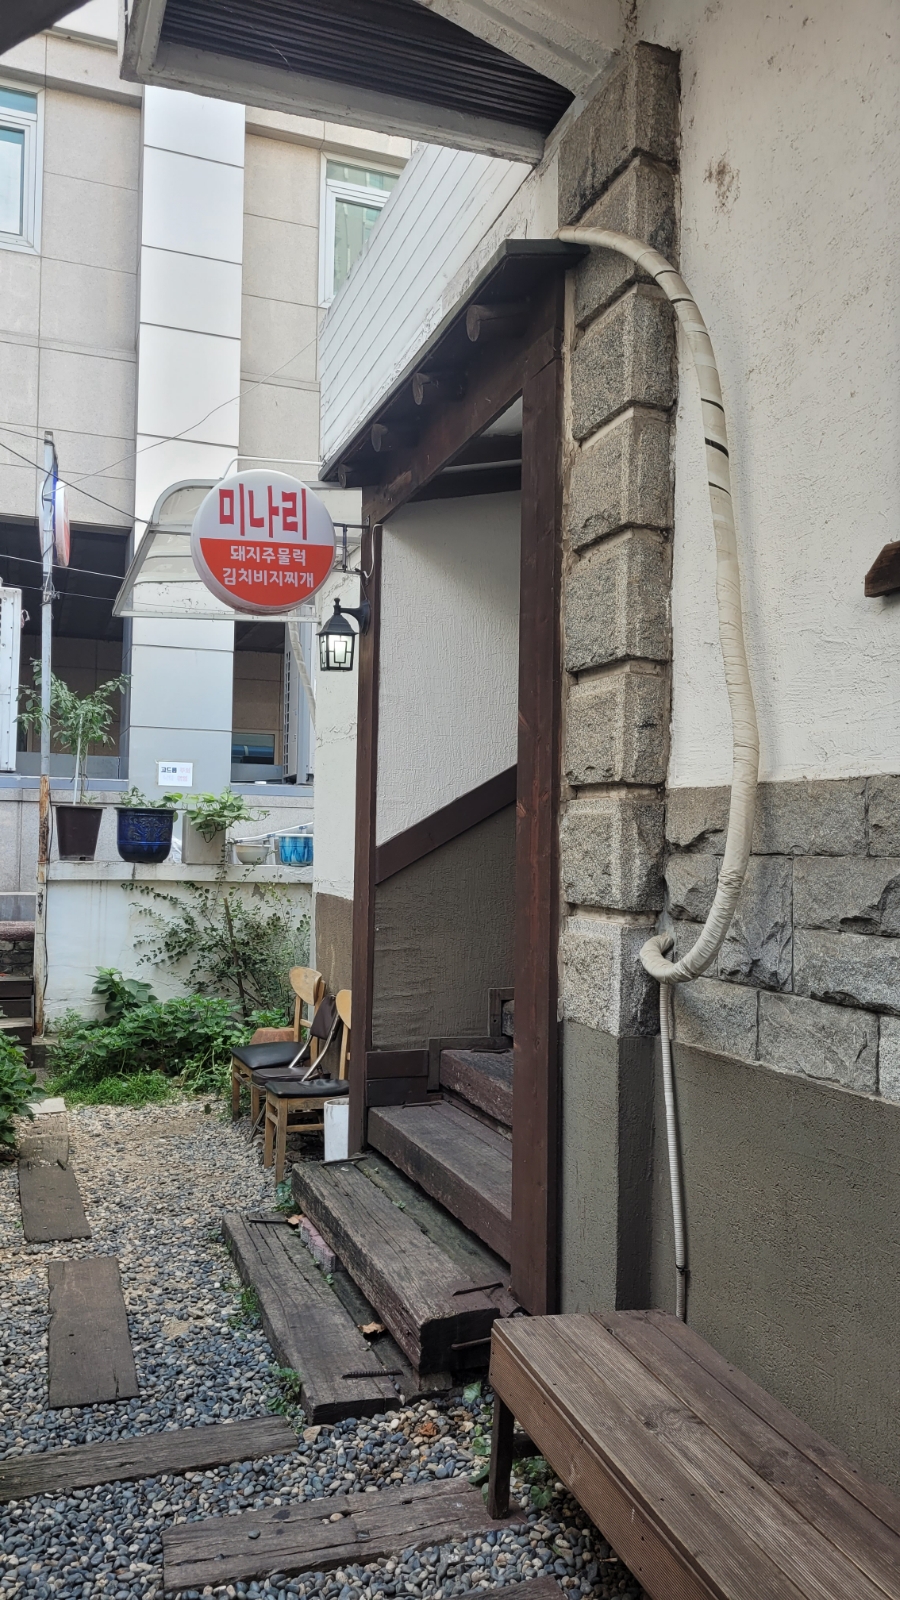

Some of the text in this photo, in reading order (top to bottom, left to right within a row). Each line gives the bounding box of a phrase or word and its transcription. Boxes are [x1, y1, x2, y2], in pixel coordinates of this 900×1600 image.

[219, 483, 307, 540] 미나리
[230, 545, 306, 566] 돼지주물럭
[222, 568, 314, 588] 김치비지찌개
